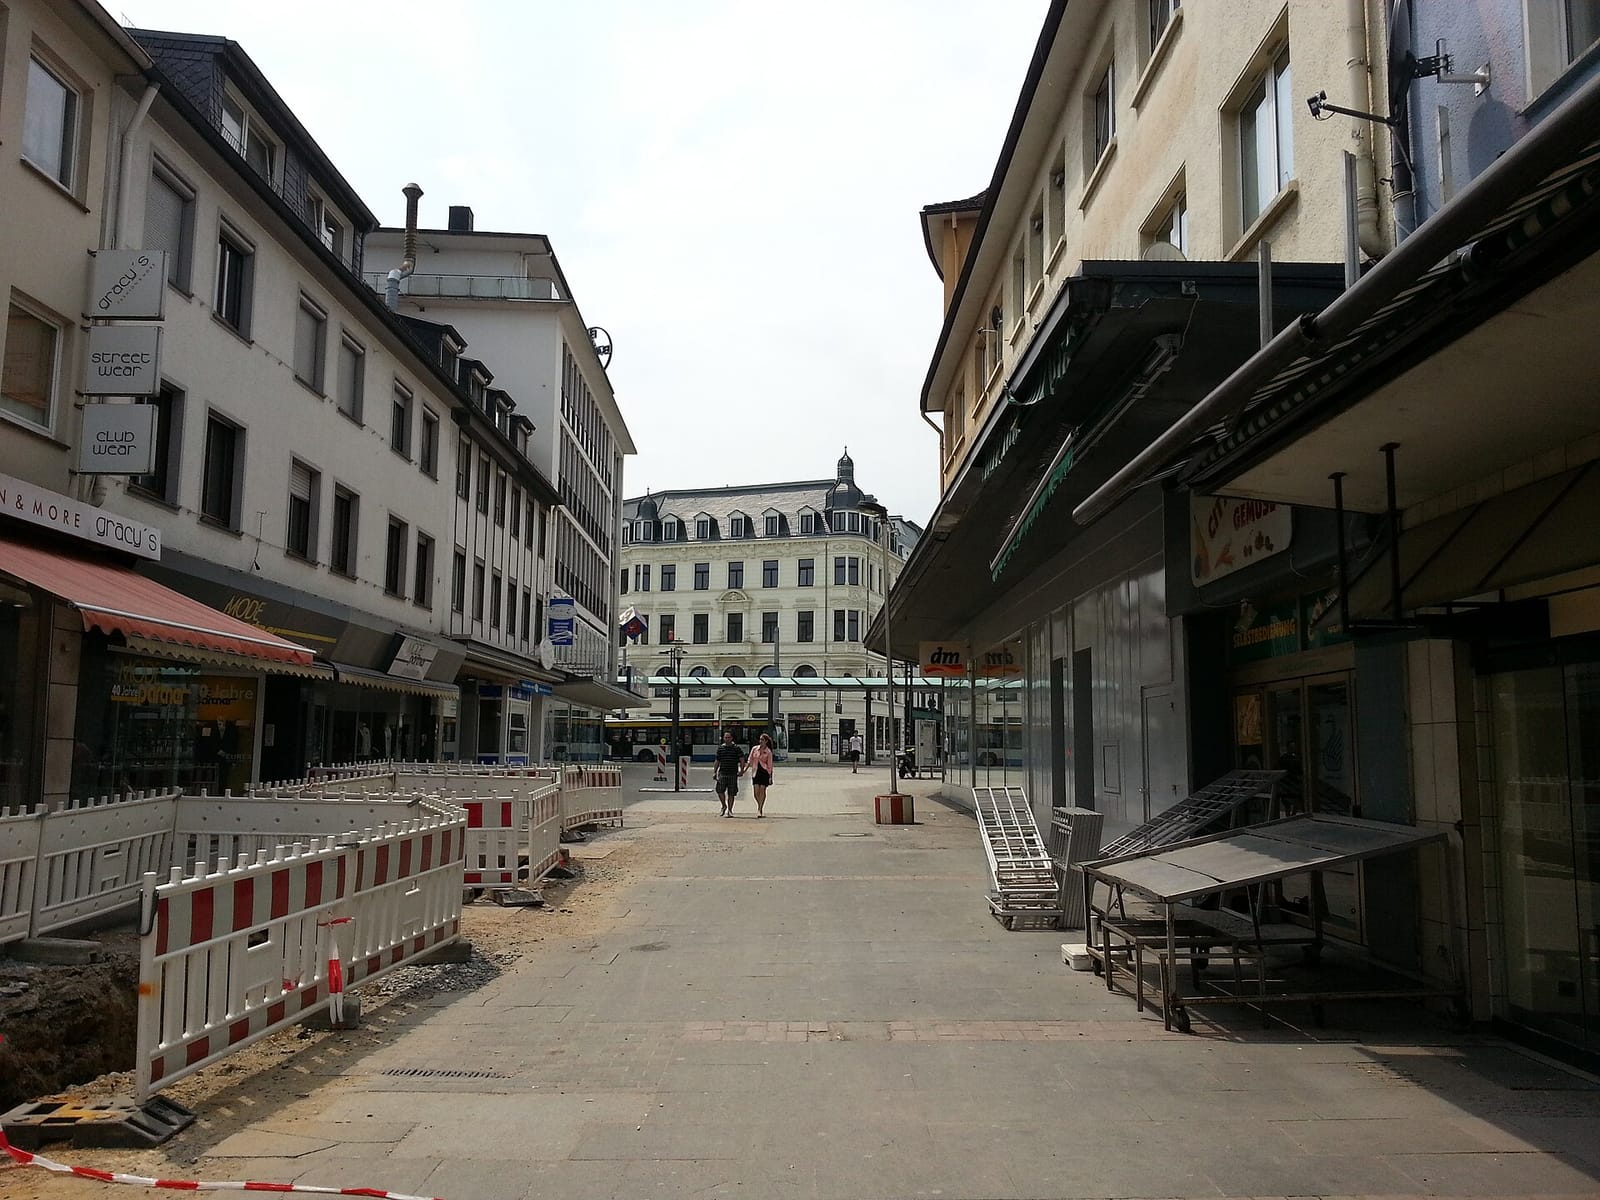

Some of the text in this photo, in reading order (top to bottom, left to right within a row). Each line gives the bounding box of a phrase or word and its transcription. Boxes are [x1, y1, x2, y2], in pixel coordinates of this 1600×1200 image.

[91, 352, 151, 364] street
[98, 366, 142, 377] wear
[92, 445, 137, 455] wear
[15, 494, 24, 511] &
[32, 500, 81, 528] MORE
[223, 594, 267, 621] MODE
[930, 646, 960, 665] dm
[111, 684, 121, 696] 40
